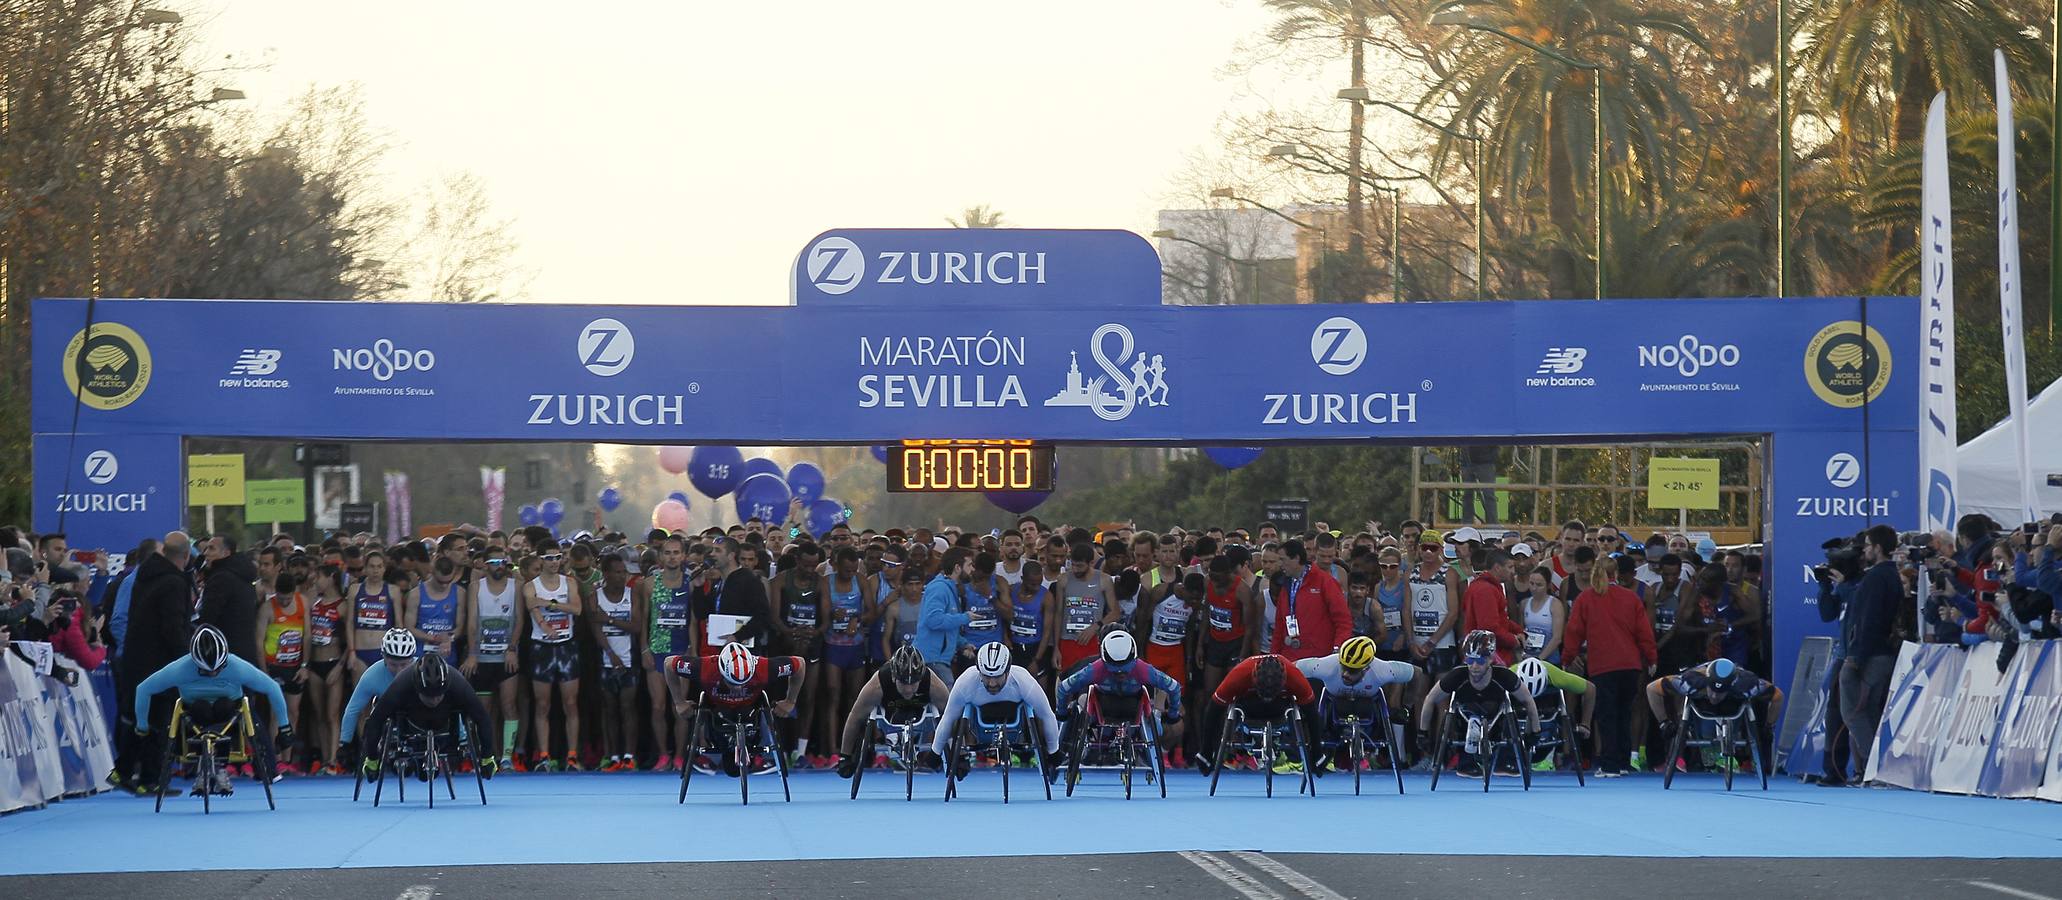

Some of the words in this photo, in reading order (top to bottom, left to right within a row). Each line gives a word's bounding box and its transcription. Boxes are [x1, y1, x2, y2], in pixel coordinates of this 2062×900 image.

[877, 251, 1047, 284] ZURICH
[860, 330, 1026, 366] MARATÓN
[1808, 338, 1821, 358] GOLD
[219, 379, 242, 388] new
[243, 378, 289, 388] balance
[334, 386, 392, 395] AYUNTAMIENTO
[393, 387, 404, 395] DE
[405, 386, 435, 396] SEVILLA
[858, 374, 1029, 408] SEVILLA
[1526, 378, 1548, 386] new
[1550, 376, 1595, 386] balance
[1639, 383, 1698, 392] AYUNTAMIENTO
[1711, 383, 1741, 391] SEVILLA
[527, 393, 684, 426] ZURICH
[1262, 392, 1417, 425] ZURICH
[1672, 481, 1686, 491] 2h
[56, 493, 147, 512] ZURICH
[1796, 497, 1889, 517] ZURICH
